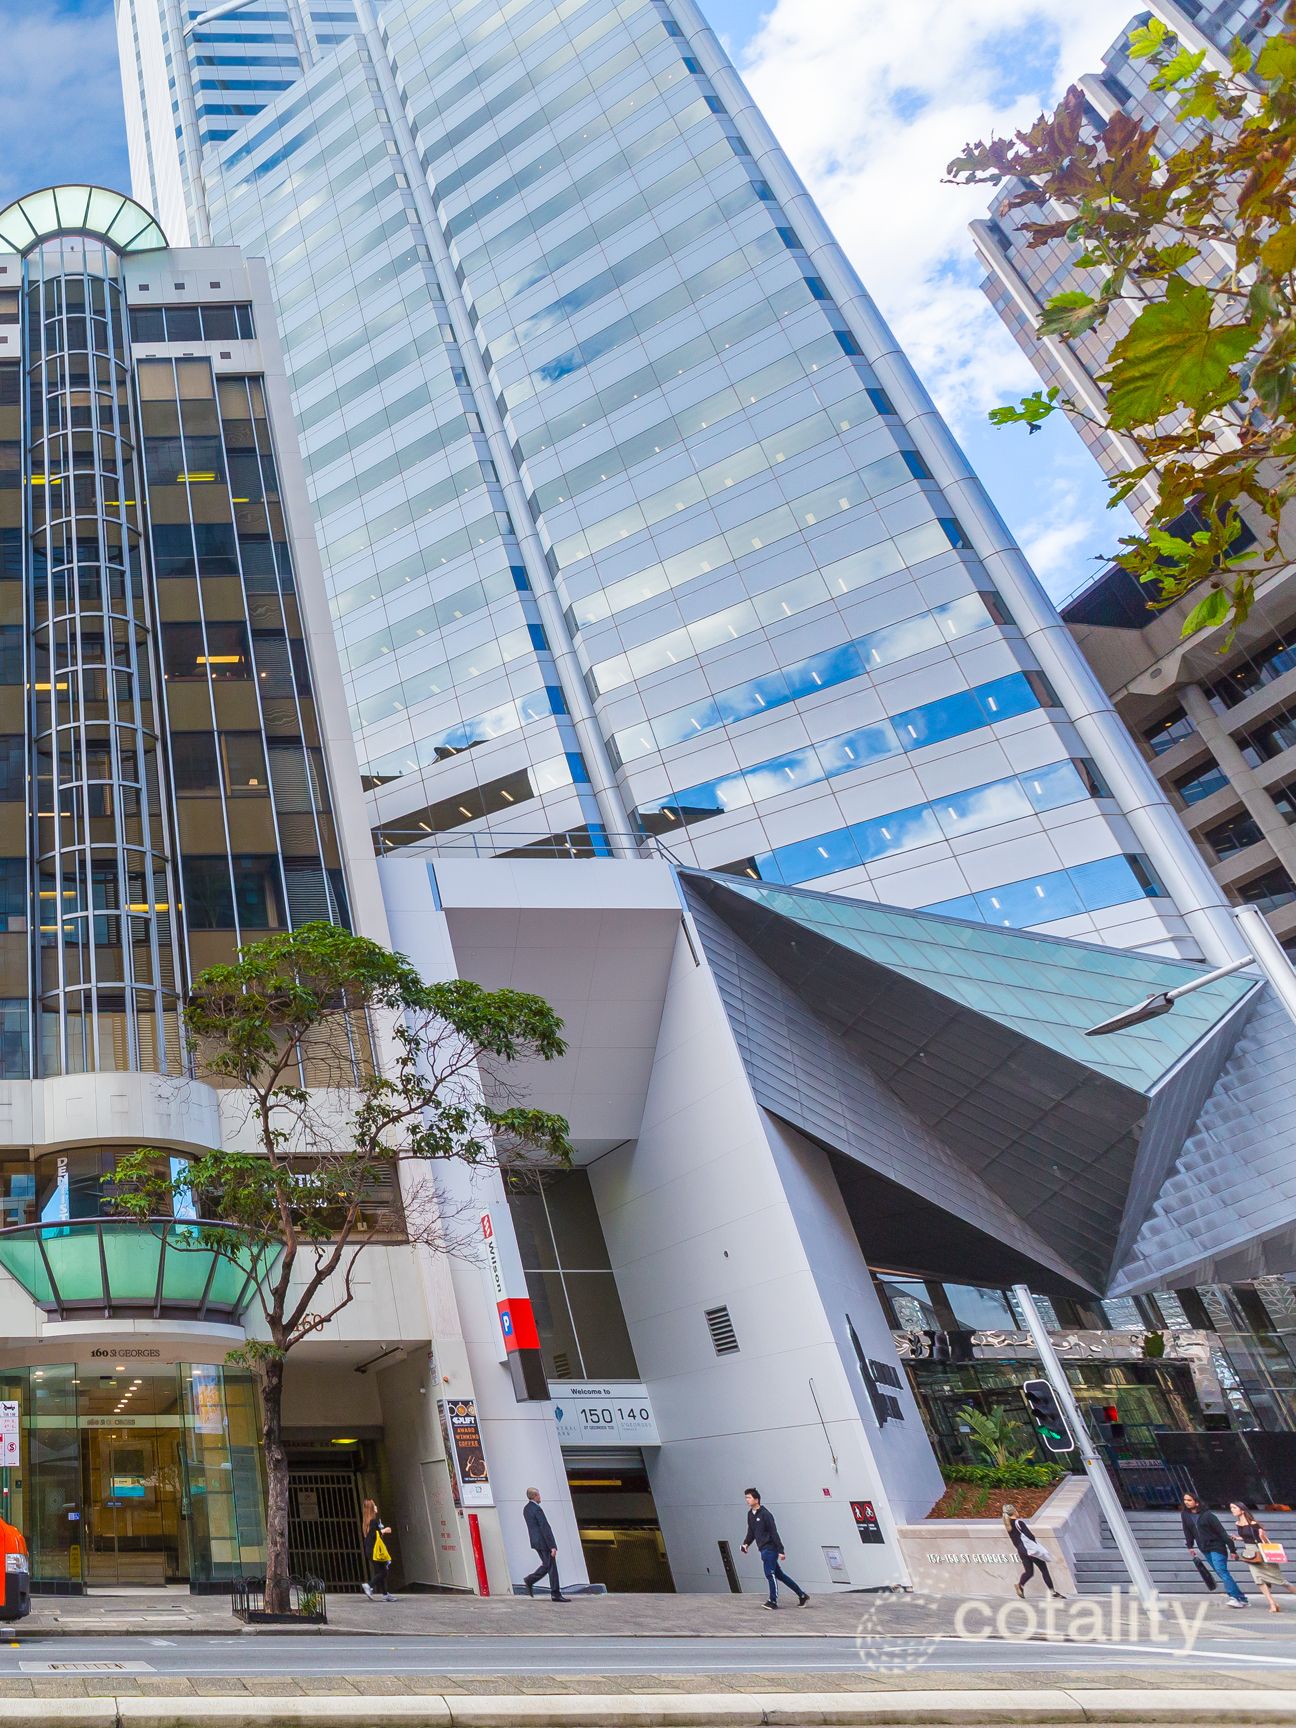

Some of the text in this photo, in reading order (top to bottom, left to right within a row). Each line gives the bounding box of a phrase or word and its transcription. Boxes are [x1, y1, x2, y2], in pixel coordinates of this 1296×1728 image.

[488, 1241, 502, 1292] Wilson
[90, 1349, 109, 1358] 160
[118, 1349, 161, 1358] GEORGES
[580, 1409, 613, 1424] 150
[618, 1408, 650, 1421] 140
[960, 1553, 971, 1563] ST
[972, 1553, 1009, 1563] GEORGES
